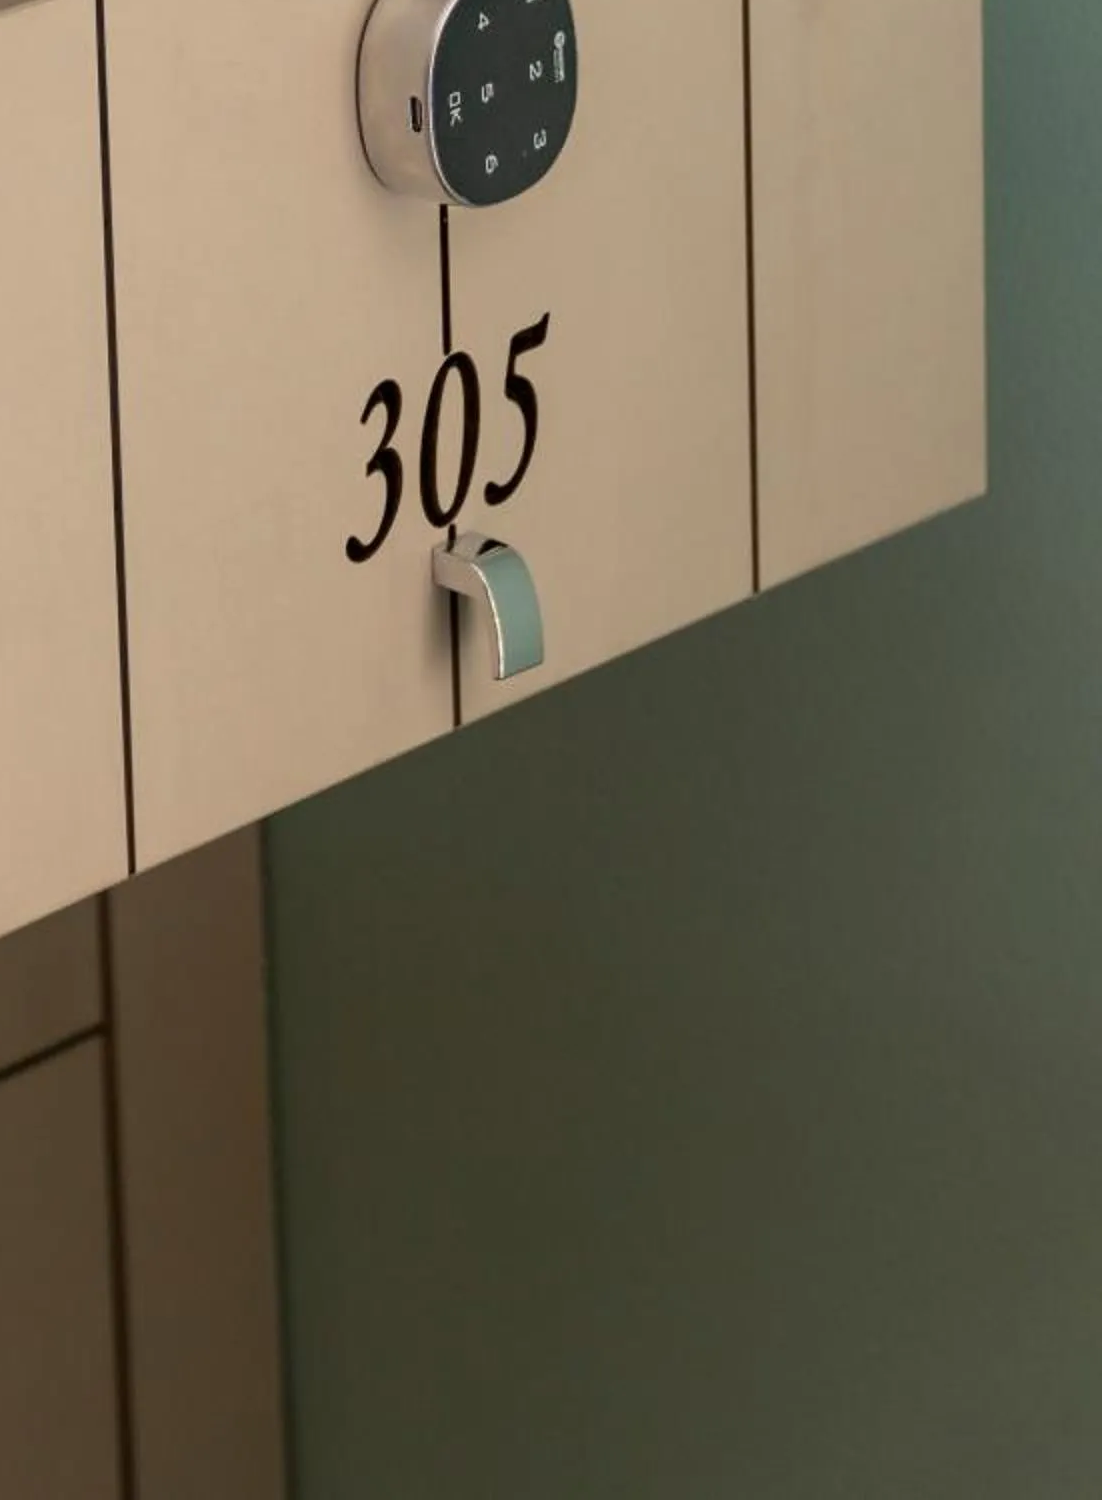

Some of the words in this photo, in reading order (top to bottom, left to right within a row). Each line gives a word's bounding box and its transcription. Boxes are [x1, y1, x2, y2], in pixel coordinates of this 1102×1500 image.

[477, 11, 491, 32] 4
[528, 59, 544, 82] 2
[480, 81, 496, 104] 5
[447, 90, 465, 128] OK
[532, 128, 548, 151] 3
[484, 153, 500, 176] 6
[345, 311, 551, 564] 305
